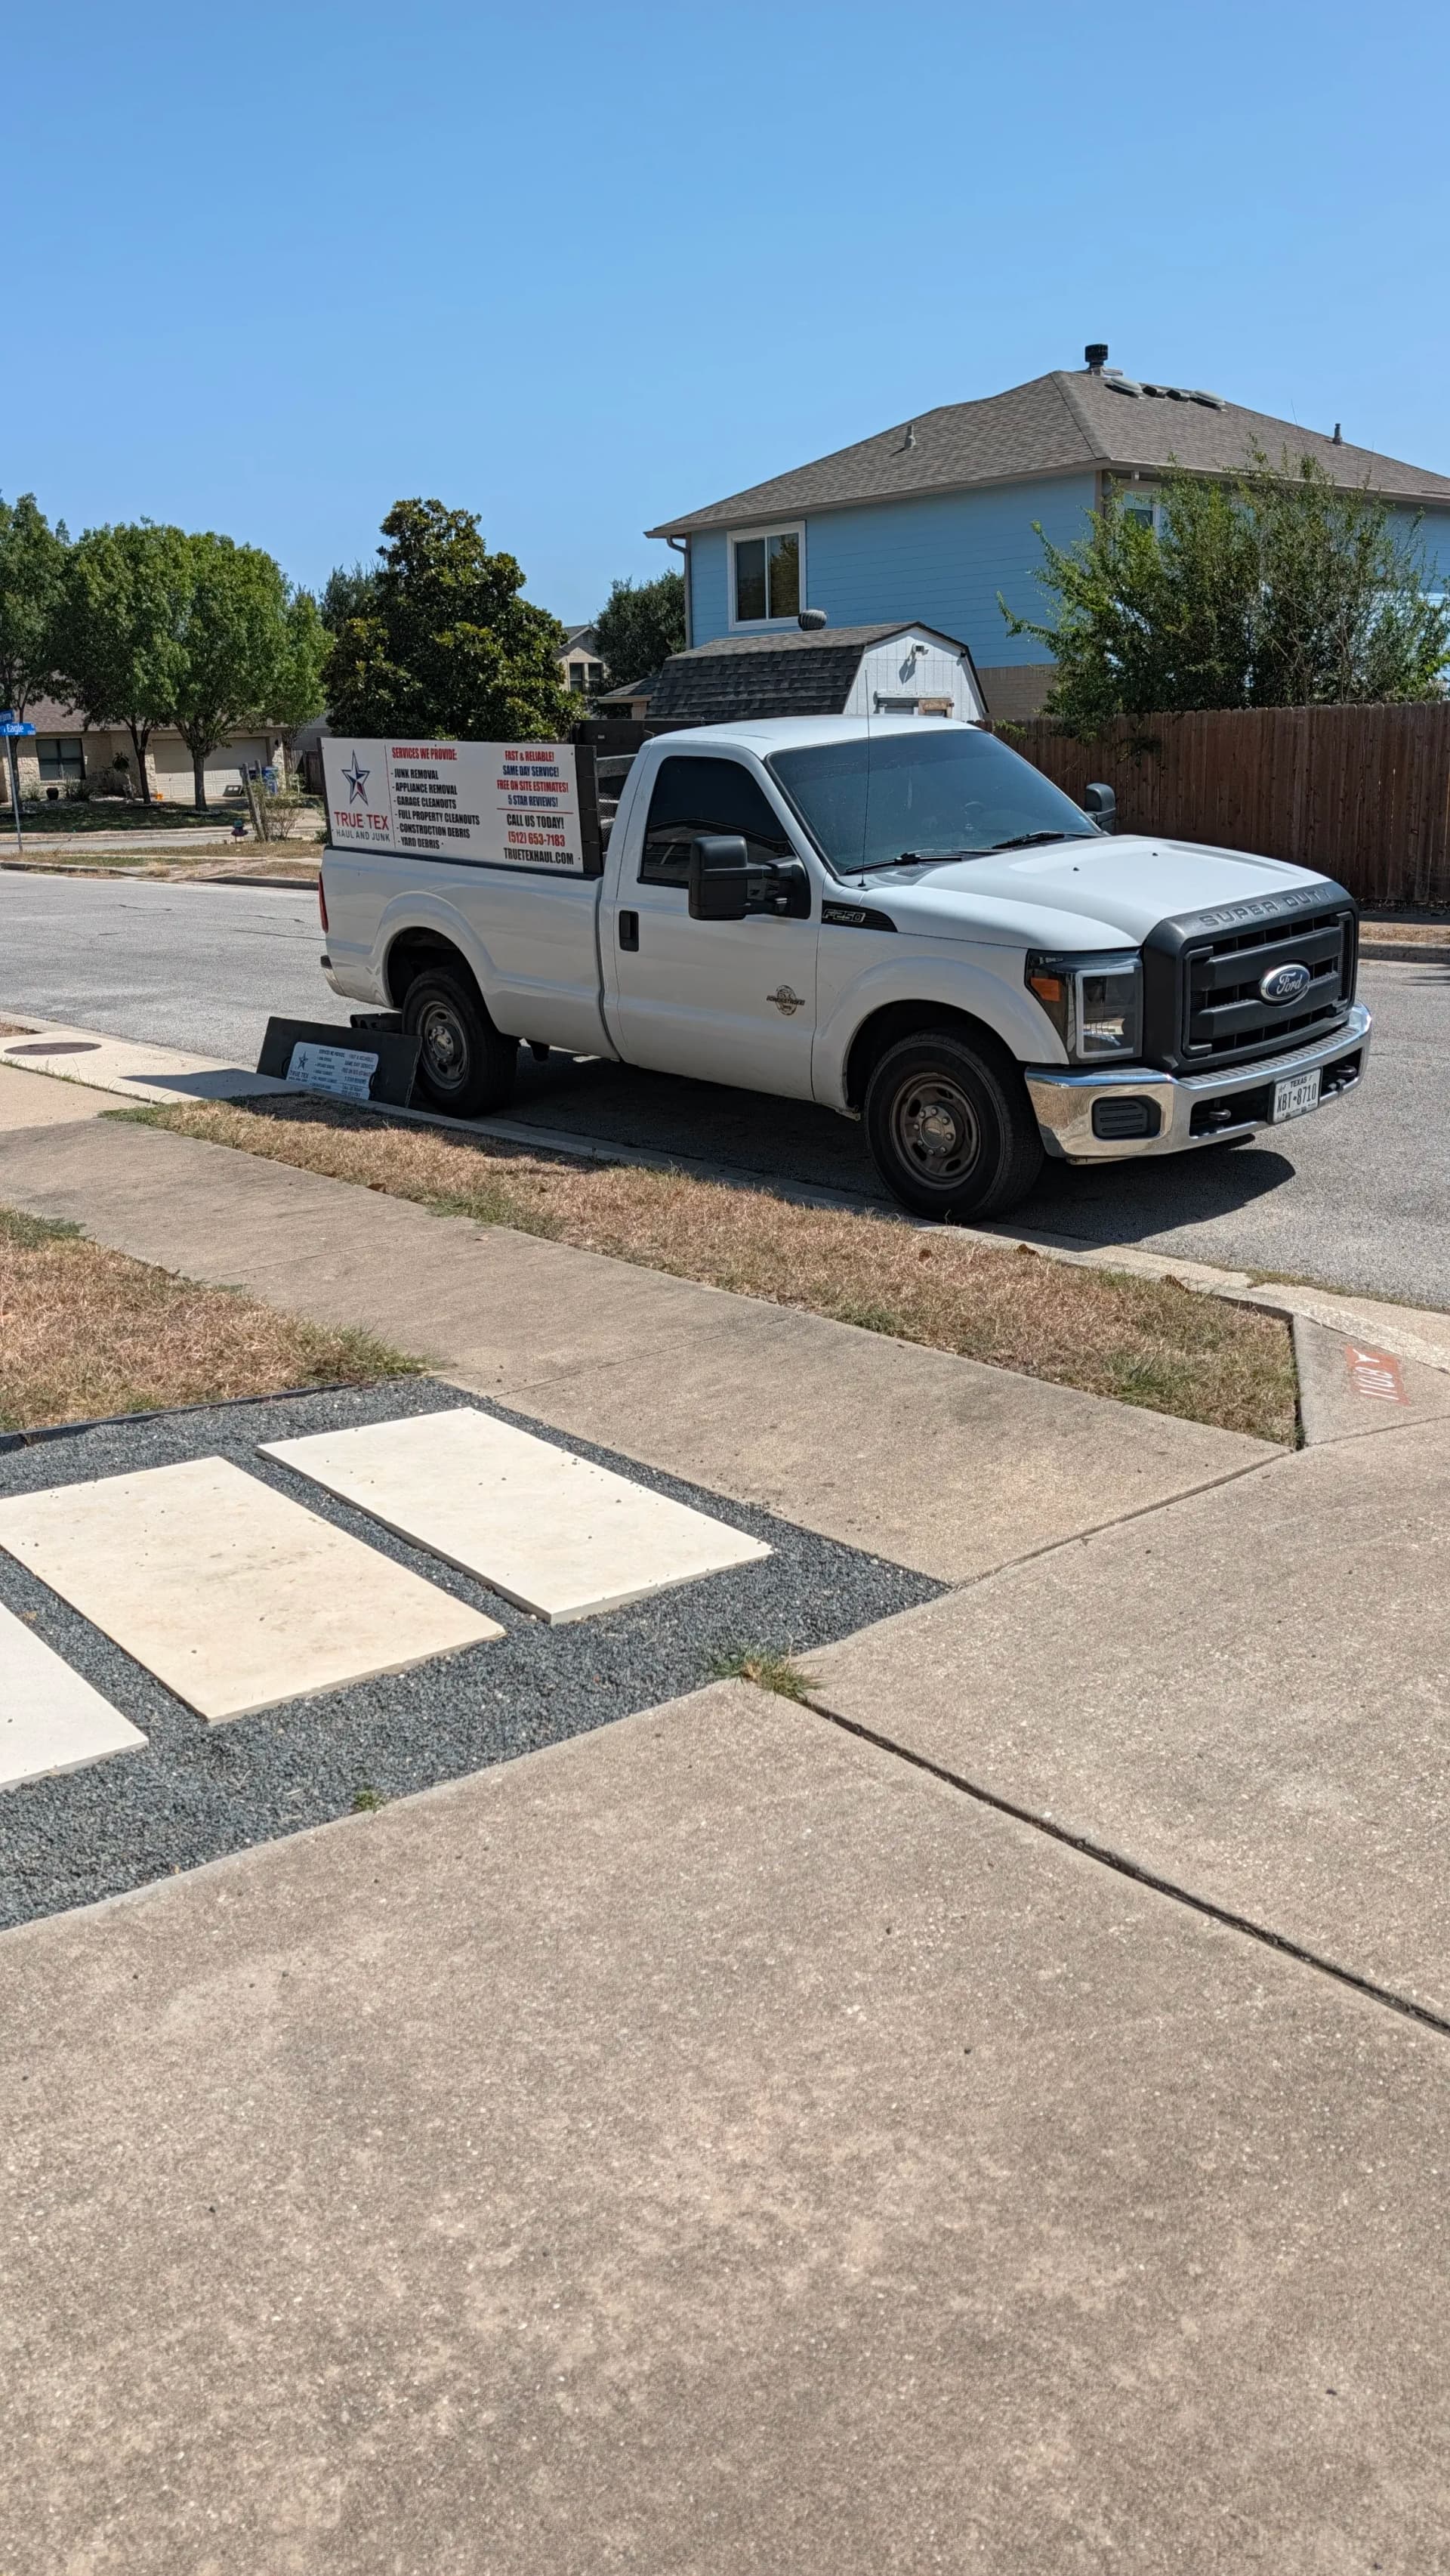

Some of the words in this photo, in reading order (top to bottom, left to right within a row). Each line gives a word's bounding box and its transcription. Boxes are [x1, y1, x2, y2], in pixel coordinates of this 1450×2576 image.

[7, 724, 23, 735] Eagle
[392, 747, 419, 759] SERVICES
[420, 748, 430, 759] WE
[430, 748, 458, 761] PROVIDE:
[504, 750, 518, 761] FAST
[520, 752, 524, 761] &
[525, 751, 554, 761] RELIABLE!
[394, 768, 409, 778] JUNK
[410, 769, 439, 780] REMOVAL
[502, 764, 519, 776] SAME
[519, 765, 530, 776] DAY
[531, 766, 560, 777] SERVICE!
[396, 783, 428, 793] APPLIANCE
[429, 784, 458, 795] REMOVAL
[497, 779, 510, 790] FREE
[510, 780, 519, 791] ON
[519, 780, 532, 791] SITE
[533, 781, 569, 793] ESTIMATES!
[396, 795, 421, 807] GARAGE
[421, 797, 457, 809] CLEANOUTS
[508, 795, 512, 805] 5
[513, 795, 528, 806] STAR
[529, 796, 558, 808] REVIEWS!
[334, 811, 364, 828] TRUE
[366, 814, 390, 830] TEX
[398, 810, 412, 820] FULL
[412, 811, 444, 822] PROPERTY
[444, 813, 480, 826] CLEANOUTS
[507, 814, 524, 826] CALL
[525, 814, 535, 827] US
[536, 815, 564, 829] TODAY!
[336, 829, 354, 839] HAUL
[356, 831, 370, 840] AND
[372, 832, 390, 842] JUNK
[400, 823, 447, 836] CONSTRUCTION
[447, 826, 470, 839] DEBRIS
[400, 836, 417, 848] YARD
[417, 838, 440, 850] DEBRIS
[508, 831, 526, 844] (512)
[528, 832, 566, 847] 653-7183
[504, 847, 574, 865] TRUETEXHAUL.COM
[1199, 900, 1281, 928] SUPER
[1282, 888, 1331, 907] DUTY
[1276, 971, 1303, 994] Ford
[1291, 1076, 1307, 1088] TEXAS
